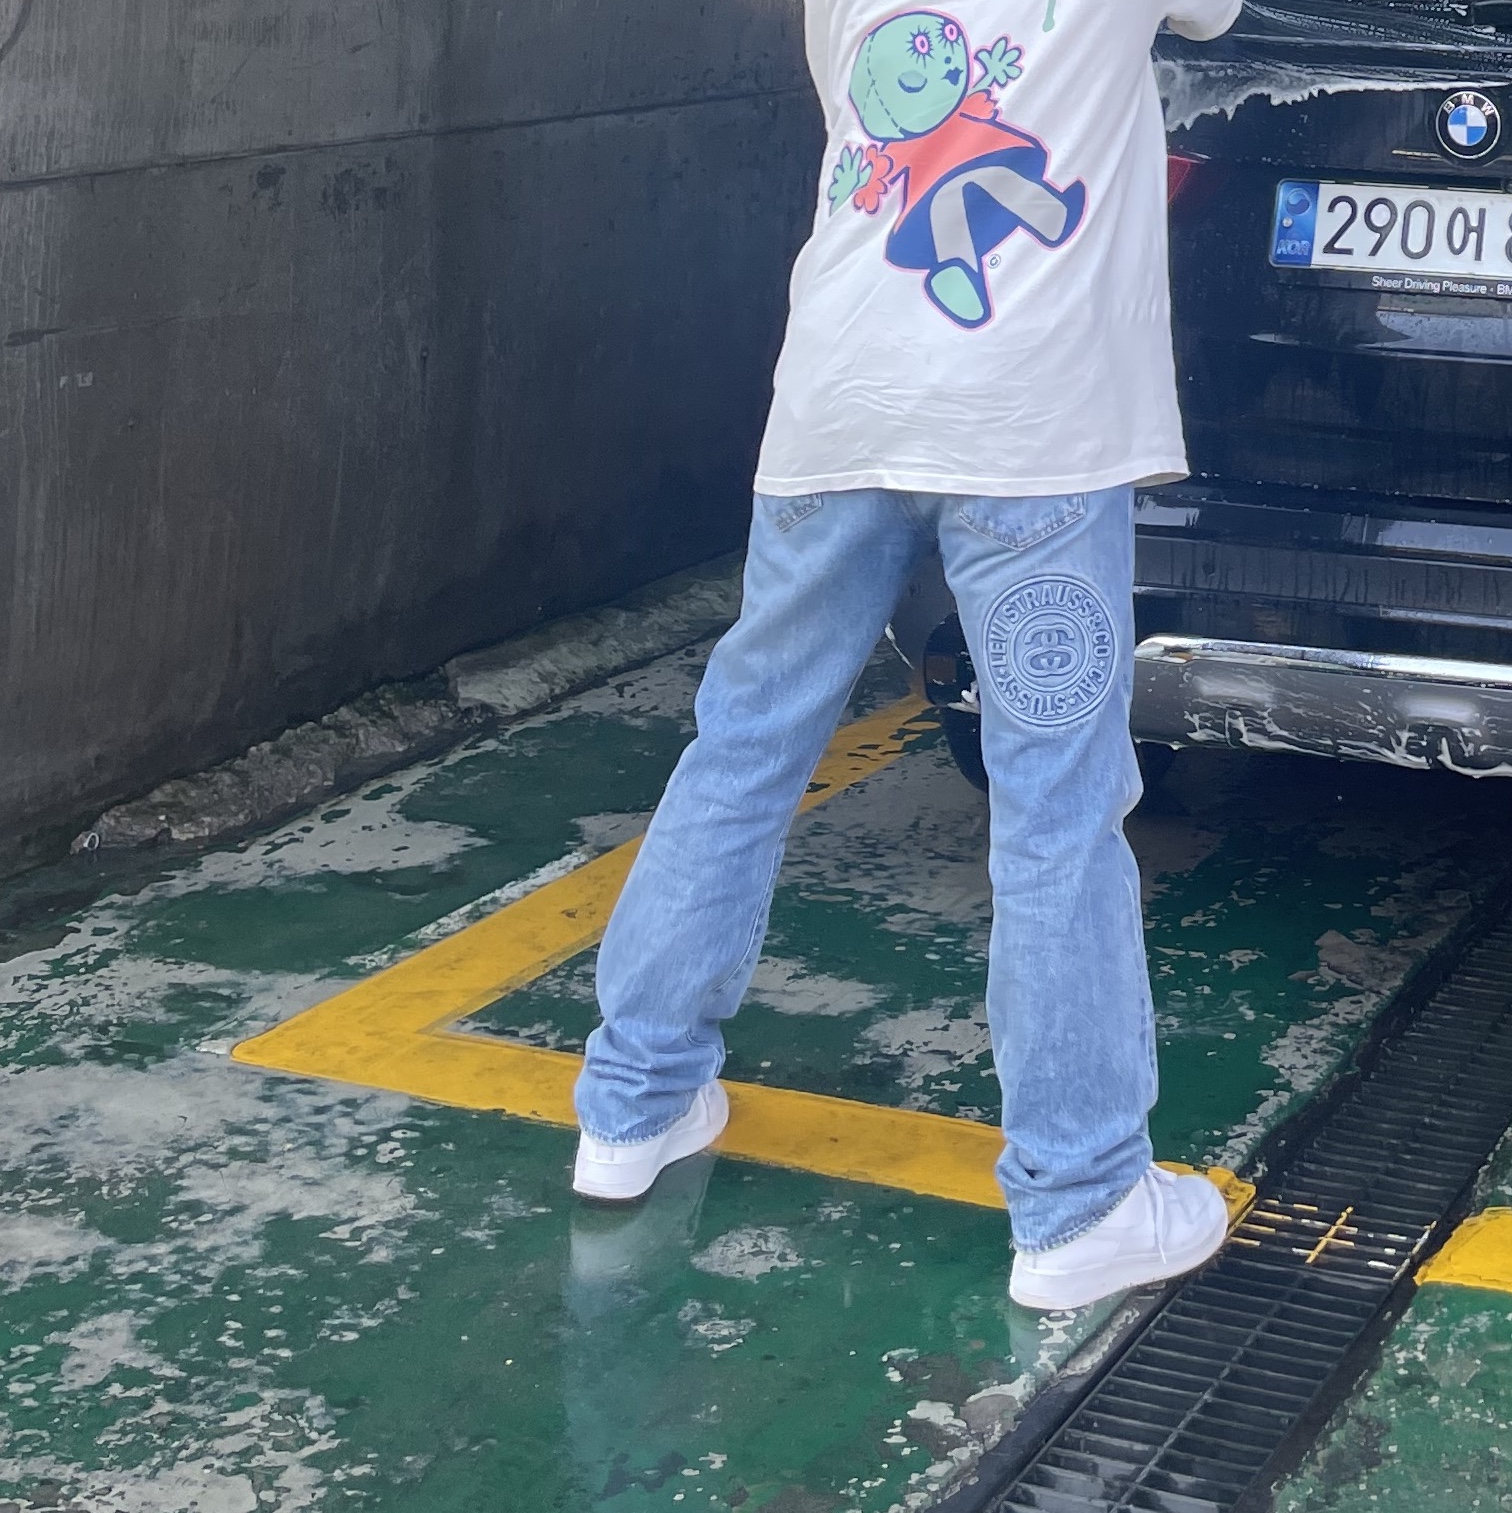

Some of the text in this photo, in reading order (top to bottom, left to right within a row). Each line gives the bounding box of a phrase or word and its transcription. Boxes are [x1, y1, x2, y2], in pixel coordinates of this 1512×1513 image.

[1443, 92, 1495, 116] BMW
[1276, 238, 1312, 256] KOR
[1323, 196, 1486, 262] 290어
[1371, 275, 1403, 288] Sheer
[1404, 278, 1441, 294] Driving
[1442, 280, 1488, 295] Pleasure
[989, 619, 1012, 668] LEVI
[1003, 585, 1092, 623] STRAUSS
[996, 674, 1067, 715] STUSSY
[1072, 666, 1105, 702] CAL
